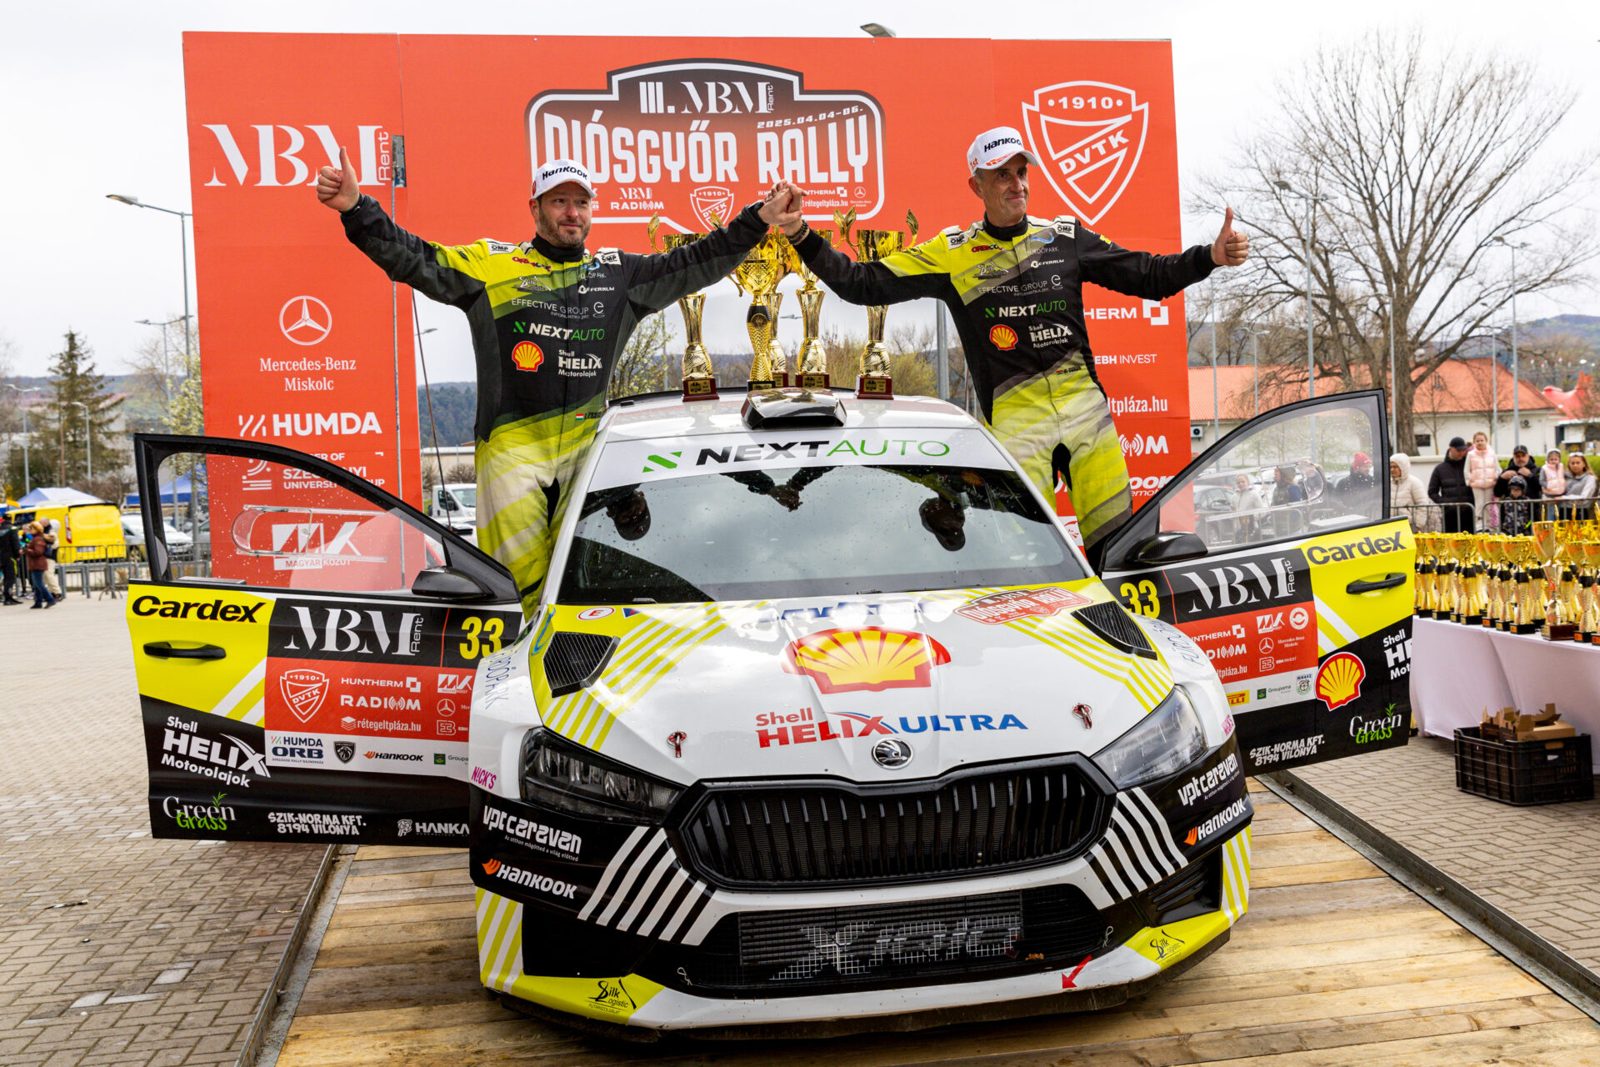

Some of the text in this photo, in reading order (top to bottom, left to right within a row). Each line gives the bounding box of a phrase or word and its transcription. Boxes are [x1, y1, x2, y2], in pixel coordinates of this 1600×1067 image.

[639, 81, 676, 114] III.
[1058, 96, 1114, 109] 1910
[543, 109, 869, 184] DIÓSGYŐR RALLY
[983, 137, 1022, 153] Hankoo
[1058, 129, 1130, 176] DVTK
[377, 131, 390, 182] Rent
[1020, 281, 1048, 292] GROUP
[511, 298, 558, 312] EFFECTIVE
[1084, 307, 1137, 320] HERM
[1030, 324, 1073, 342] HELIX
[259, 357, 357, 372] Mercedes-Benz
[558, 353, 603, 369] HELIX
[1119, 354, 1157, 364] INVEST
[284, 377, 334, 392] Miskolc
[1108, 395, 1168, 417] ltpláza.hu
[272, 411, 383, 437] HUMDA
[1307, 532, 1407, 566] Cardex
[1120, 579, 1161, 619] 33
[132, 595, 267, 623] Cardex
[411, 614, 424, 653] Rent
[459, 616, 504, 660] 33
[1383, 629, 1406, 647] Shell
[294, 674, 316, 682] 1910
[341, 677, 403, 688] HUNTHERM
[292, 688, 321, 704] DVTK
[167, 715, 198, 733] Shell
[357, 719, 422, 732] rétegeltpláza.hu
[755, 707, 813, 727] Shell
[1350, 713, 1402, 738] Green
[755, 711, 1029, 749] HELIX ULTRA
[1355, 727, 1394, 744] Grass
[283, 736, 324, 747] HUMDA
[162, 728, 271, 778] HELIX
[272, 746, 324, 759] ORB
[1254, 755, 1280, 767] 8194
[160, 753, 250, 788] Motorolajok
[471, 766, 497, 790] NICK'S
[162, 795, 236, 821] Green
[176, 812, 228, 831] Grass
[268, 811, 367, 827] SZIK-NORMA KFT.
[277, 823, 360, 836] 8194 VILONYA
